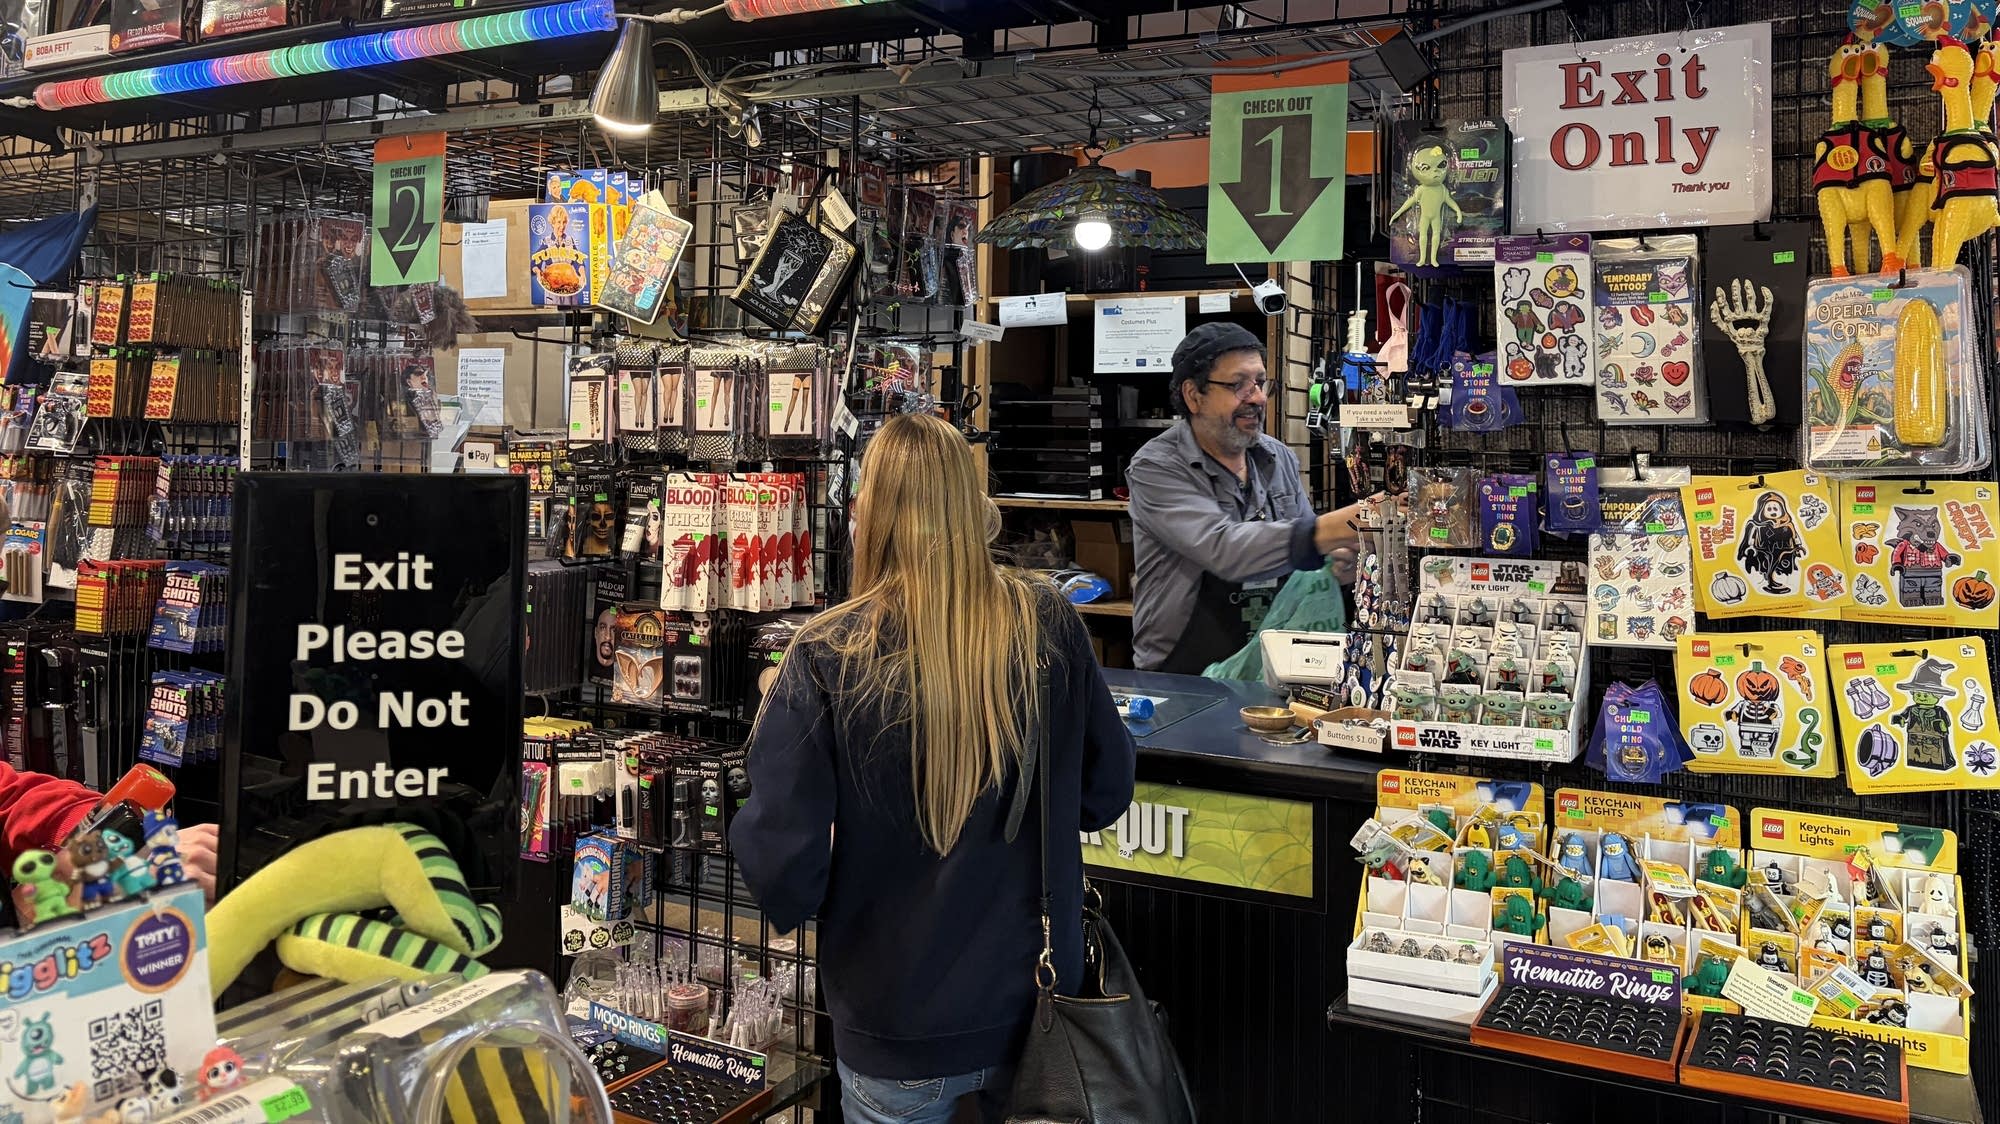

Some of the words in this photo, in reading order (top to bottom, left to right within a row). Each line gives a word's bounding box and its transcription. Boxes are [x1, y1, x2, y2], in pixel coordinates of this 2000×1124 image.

[36, 43, 52, 56] BOBA
[53, 41, 70, 53] FETT
[1559, 53, 1708, 110] Exit
[1242, 101, 1285, 114] CHECK
[1286, 97, 1313, 112] OUT
[1549, 116, 1720, 175] Only
[1458, 160, 1493, 168] STRETCHY
[390, 166, 411, 179] CHECK
[412, 165, 427, 177] OUT
[1255, 125, 1294, 217] 1
[1452, 169, 1499, 184] ALIEN
[1672, 182, 1706, 193] Thank
[1708, 181, 1730, 192] you
[391, 186, 420, 252] 2
[531, 246, 588, 265] TURKEY
[1602, 273, 1653, 285] TEMPORARY
[1608, 282, 1648, 293] TATTOOS
[1816, 303, 1877, 324] OPERA
[1831, 321, 1882, 342] CORN
[475, 451, 490, 462] Pay
[510, 452, 517, 460] FX
[517, 451, 541, 461] MAKE-UP
[1564, 485, 1584, 493] RING
[1858, 491, 1875, 499] LEGO
[666, 489, 713, 506] BLOOD
[1488, 494, 1519, 503] CHUNKY
[1697, 492, 1713, 501] LEGO
[1491, 504, 1518, 512] STONE
[1601, 502, 1647, 513] EMPORARY
[666, 512, 712, 527] THICK
[1496, 513, 1515, 521] RING
[1604, 511, 1644, 521] TATTOOS
[1963, 503, 1995, 539] STAY
[1721, 506, 1735, 539] TREAT
[14, 528, 39, 539] CIGARS
[1700, 525, 1716, 561] BRICK
[332, 552, 433, 591] Exit
[1493, 564, 1534, 574] STAR
[166, 576, 200, 591] STEEL
[1493, 573, 1534, 582] WARS
[162, 587, 201, 602] SHOTS
[1470, 584, 1486, 592] KEY
[1487, 585, 1510, 593] LIGHT
[296, 621, 466, 664] Please
[1694, 644, 1709, 653] LEGO
[80, 648, 108, 658] HALLOWEEN
[1961, 647, 1973, 656] 5x
[1311, 657, 1324, 667] Pay
[1846, 656, 1863, 665] LEGO
[154, 687, 187, 703] STEEL
[150, 698, 187, 717] SHOTS
[288, 693, 359, 732] Do
[378, 690, 470, 728] Not
[1327, 731, 1354, 743] Buttons
[1356, 735, 1378, 745] $1.00
[1399, 731, 1415, 740] LEGO
[1419, 728, 1461, 739] STAR
[1621, 736, 1643, 744] RING
[1418, 738, 1461, 749] WARS
[1470, 739, 1490, 749] KEY
[1493, 740, 1521, 751] LIGHT
[721, 750, 745, 759] mehron
[722, 759, 744, 769] Spray
[675, 767, 699, 776] Barrier
[700, 769, 719, 779] Spray
[306, 760, 449, 801] Enter
[1383, 781, 1399, 789] LEGO
[1404, 777, 1457, 790] KEYCHAIN
[1404, 788, 1441, 798] LIGHTS
[1561, 799, 1577, 808] LEGO
[1584, 796, 1641, 810] KEYCHAIN
[1584, 806, 1625, 818] LIGHTS
[1763, 824, 1783, 834] LEGO
[1799, 821, 1851, 837] Keychain
[1799, 833, 1835, 848] Lights
[610, 851, 622, 912] HANDICORN
[564, 909, 576, 918] 30
[134, 929, 176, 949] TOTY
[137, 954, 185, 976] WINNER
[1509, 956, 1606, 991] Hematite
[1608, 971, 1674, 1005] Rings
[593, 1006, 627, 1031] MOOD
[627, 1020, 661, 1044] RINGS
[671, 1043, 725, 1072] Hematite
[725, 1057, 763, 1086] Rings
